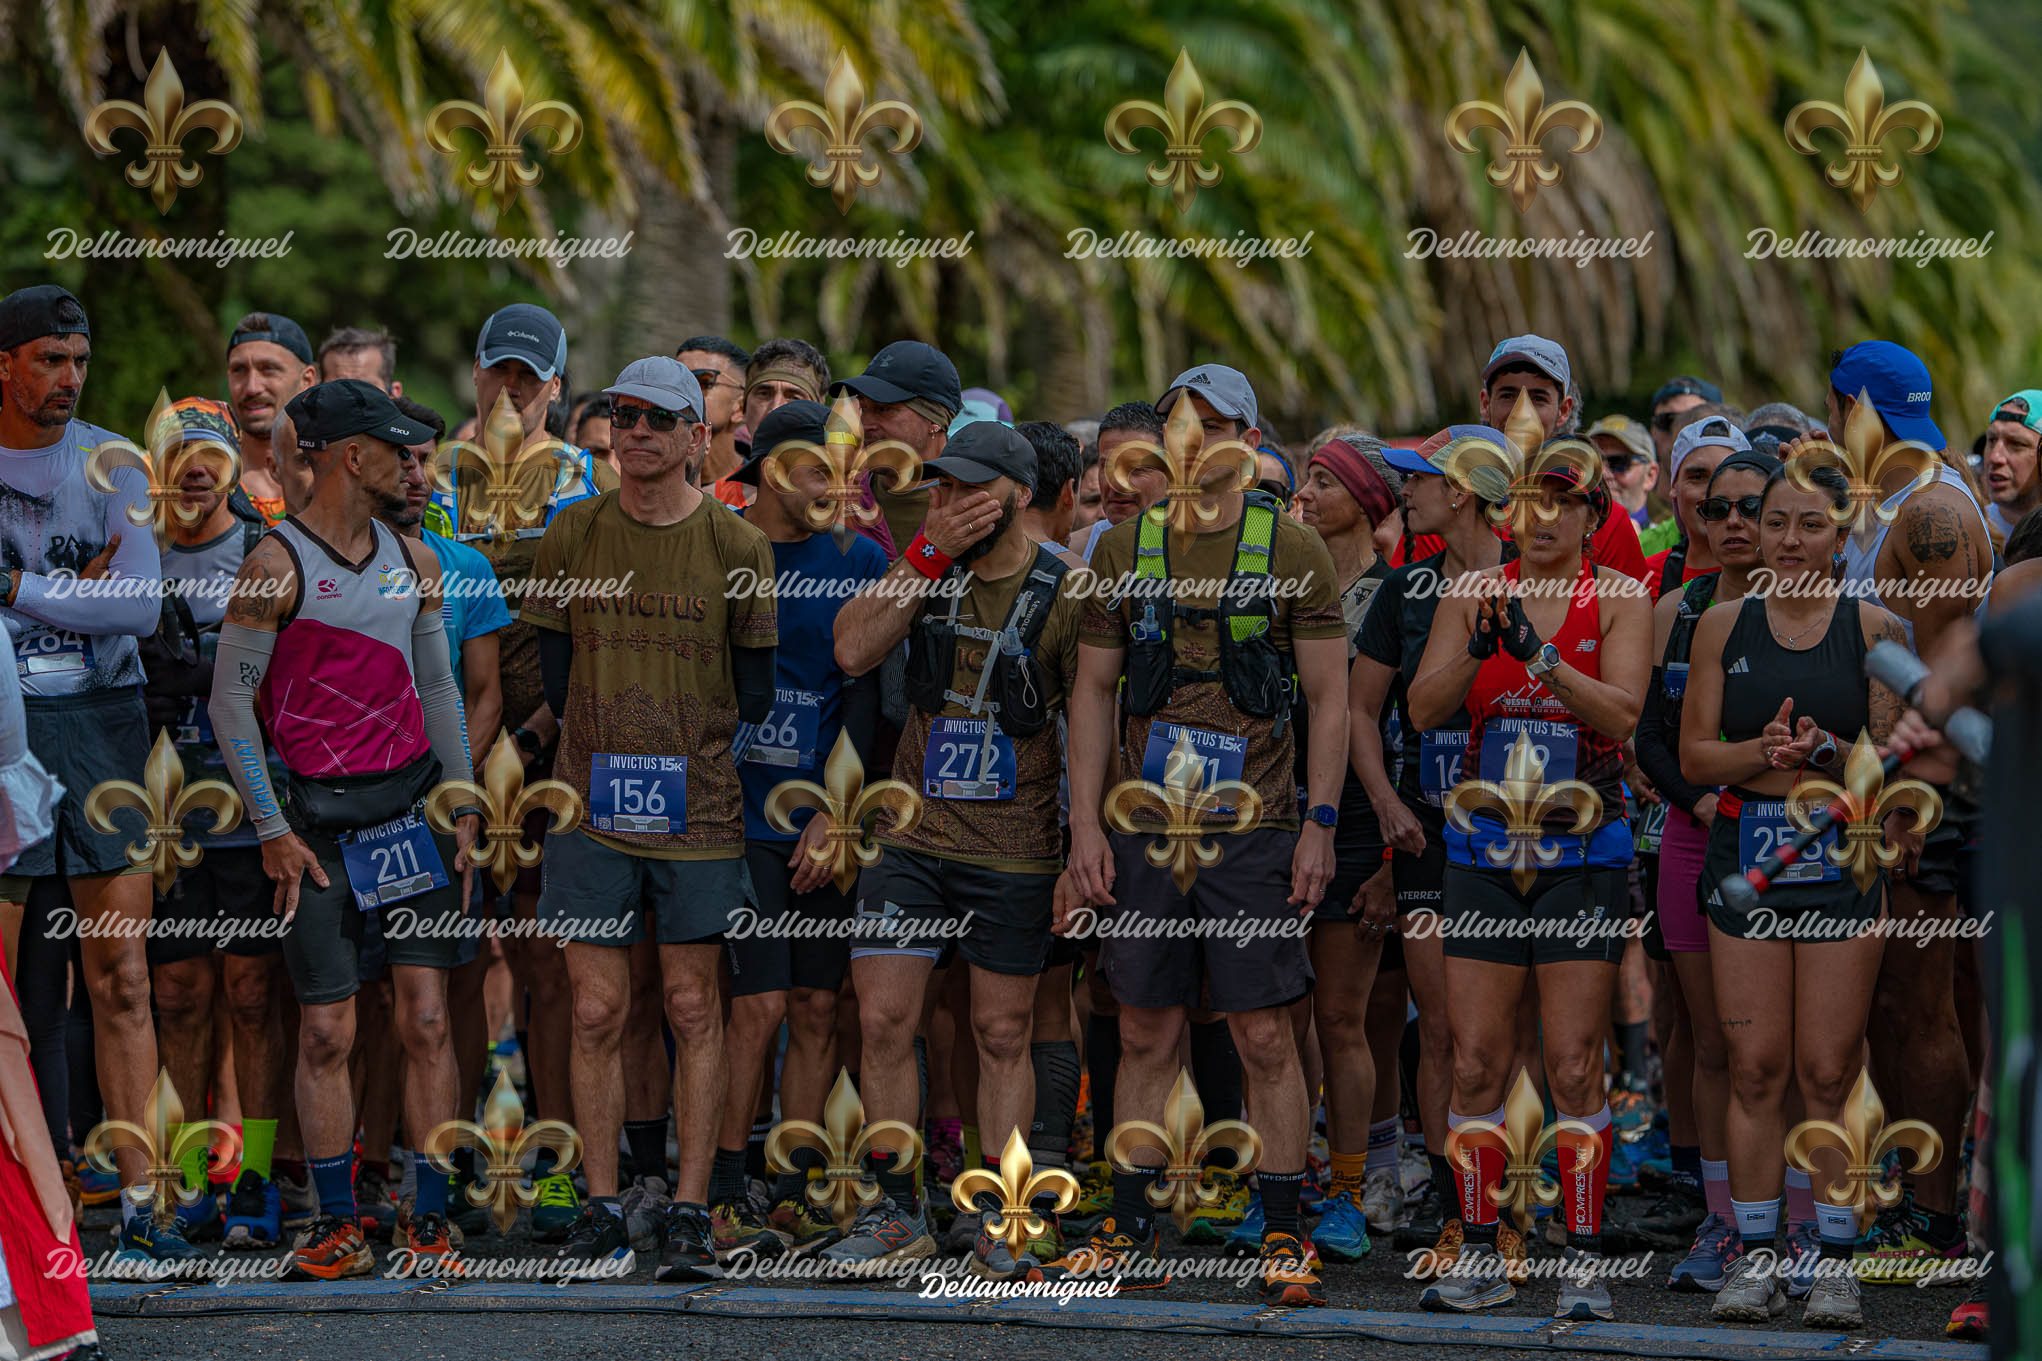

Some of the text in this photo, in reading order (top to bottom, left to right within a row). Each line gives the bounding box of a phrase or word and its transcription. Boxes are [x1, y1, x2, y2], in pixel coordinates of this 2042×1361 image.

[584, 587, 706, 623] INVICTUS
[943, 719, 988, 734] INVICTUS
[1168, 726, 1217, 748] INVICTUS
[1435, 731, 1470, 745] INVICTU
[1501, 719, 1549, 736] INVICTUS
[610, 755, 657, 770] INVICTUS
[938, 742, 1000, 779] 272
[1164, 750, 1220, 793] 271
[230, 737, 278, 818] URUGUAY
[609, 778, 666, 815] 156
[1757, 802, 1805, 817] INVICTUS
[357, 819, 404, 843] INVICTUS
[370, 839, 421, 884] 211
[1403, 890, 1442, 900] TERREX
